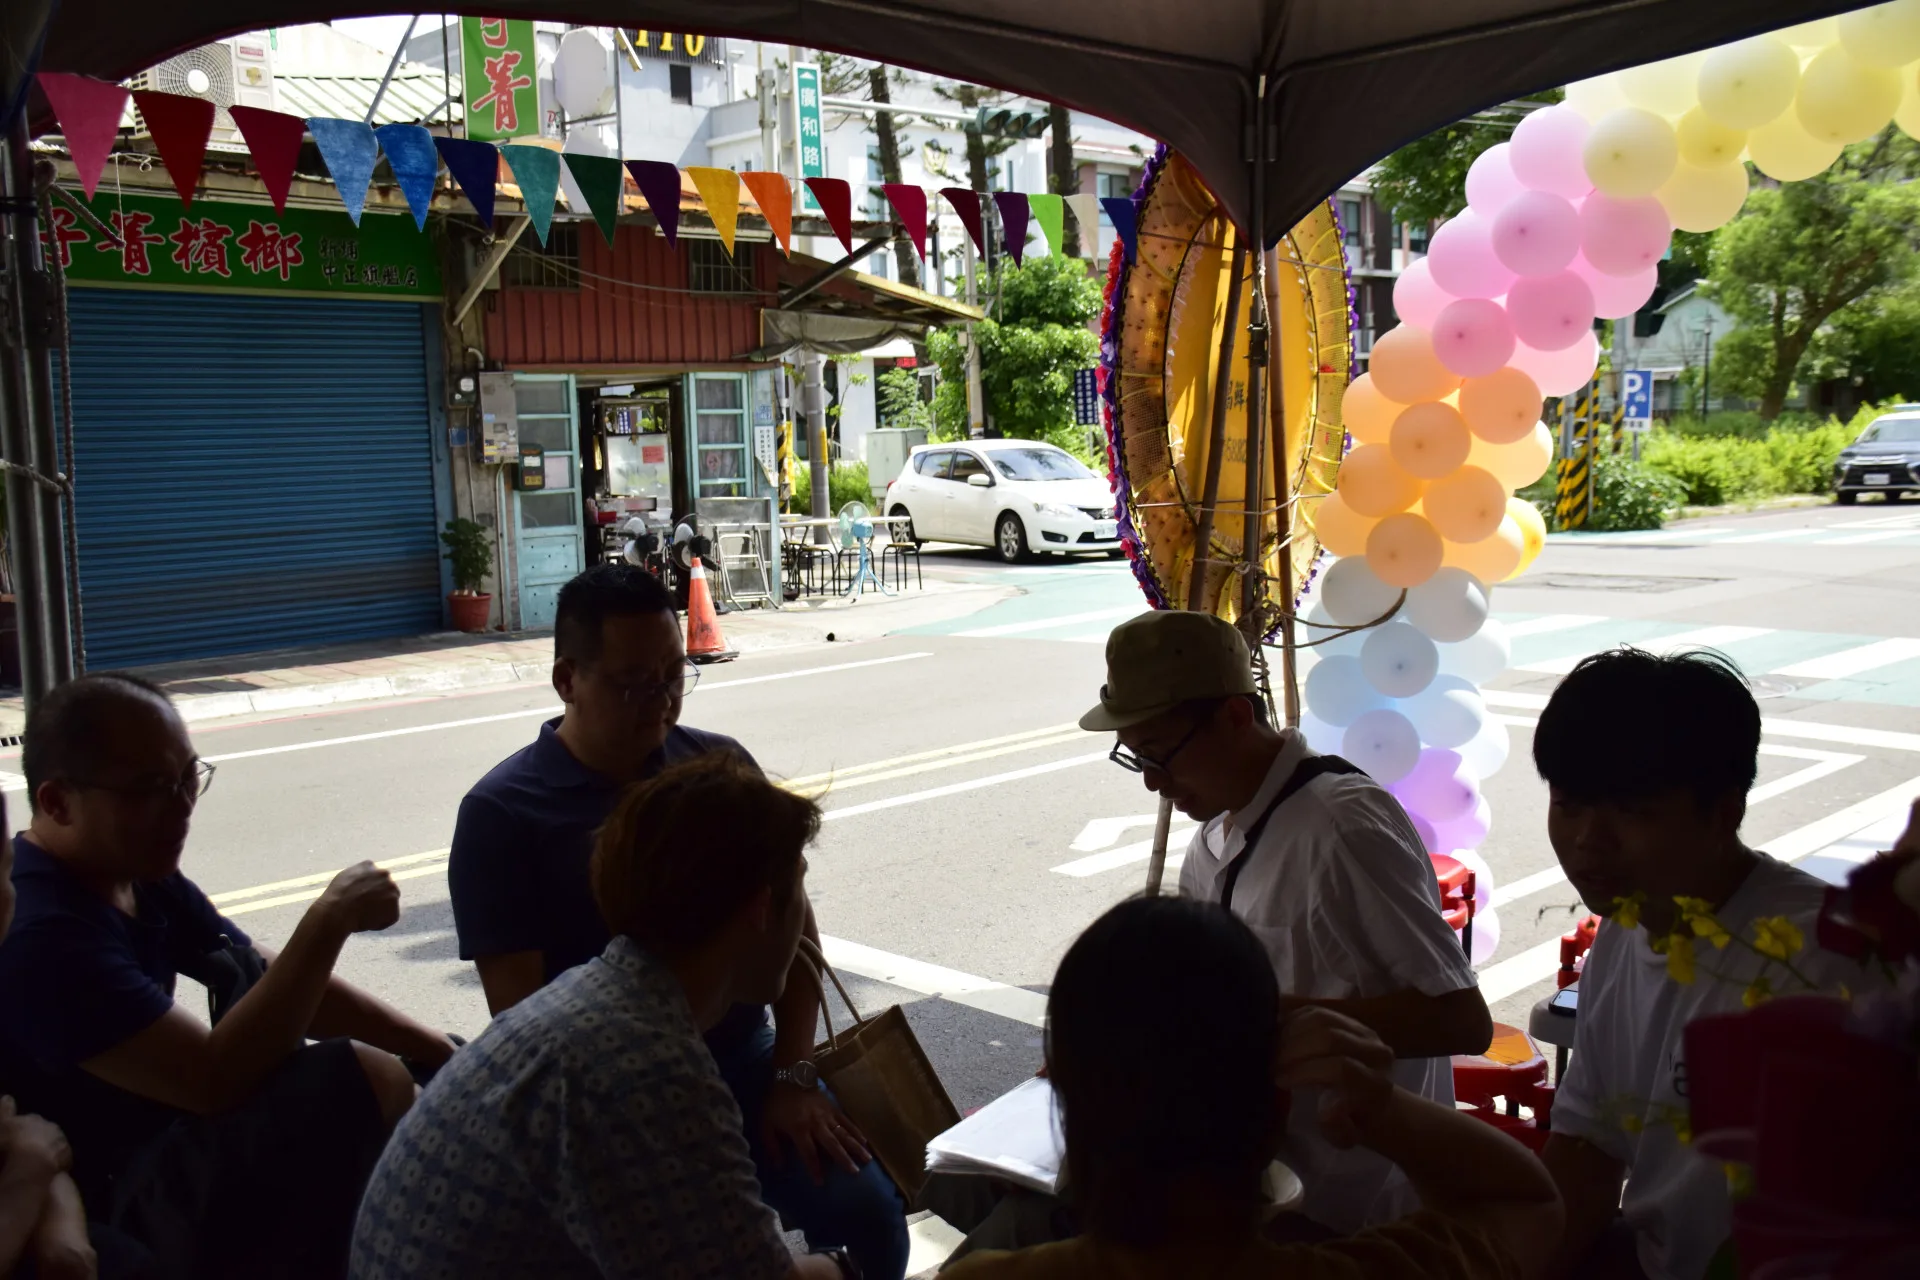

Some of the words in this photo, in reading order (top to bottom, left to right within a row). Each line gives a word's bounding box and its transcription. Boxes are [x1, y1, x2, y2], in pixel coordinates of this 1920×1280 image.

[801, 87, 819, 166] 廣和路
[1623, 373, 1643, 401] P
